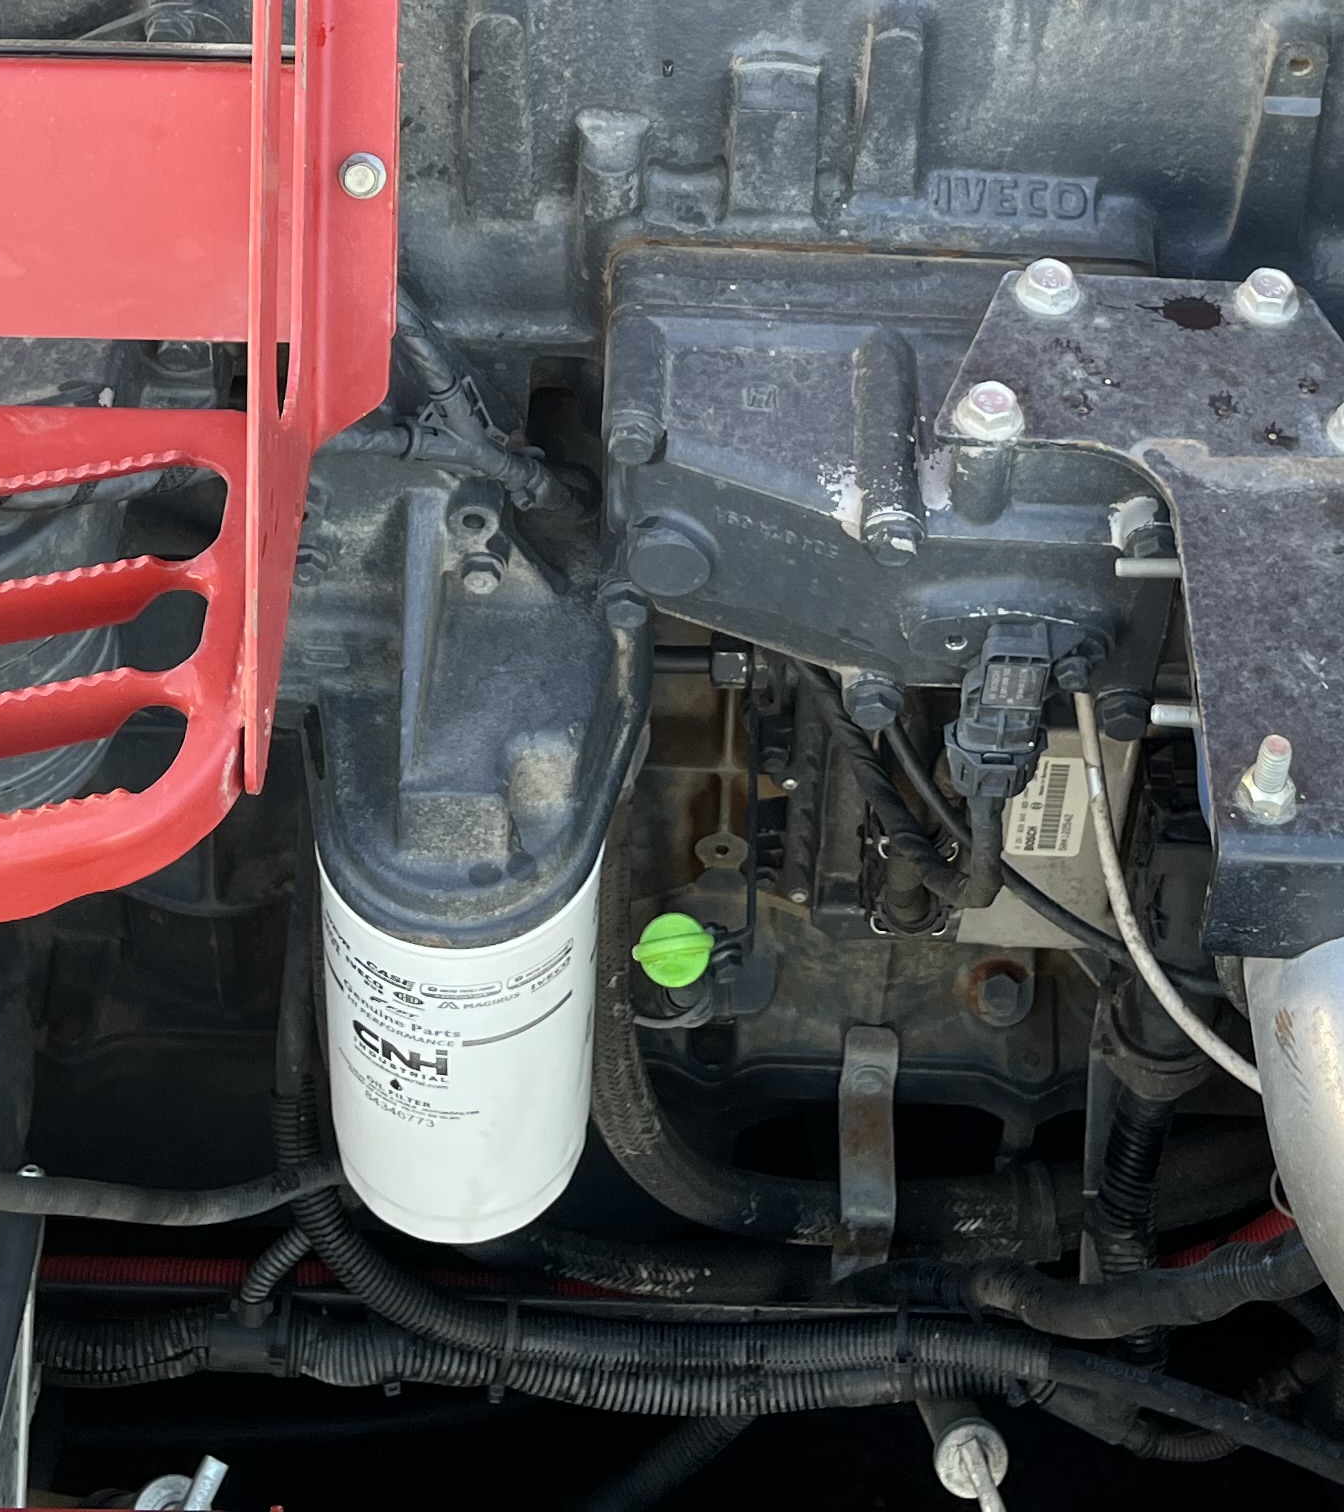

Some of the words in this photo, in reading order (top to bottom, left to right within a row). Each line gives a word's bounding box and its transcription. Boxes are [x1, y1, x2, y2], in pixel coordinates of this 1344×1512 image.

[932, 173, 1088, 221] IVECO
[1024, 826, 1037, 851] BOSCH
[345, 955, 384, 990] IVECO
[366, 960, 416, 992] CASE
[531, 956, 571, 991] IVECO
[343, 979, 405, 1029] Genuine
[411, 1023, 462, 1038] Parts
[463, 992, 520, 1009] MAGIRUS
[360, 1007, 455, 1048] PERFORMANCE
[353, 1036, 449, 1083] INDUSTRIAL
[388, 1089, 431, 1109] FILTER
